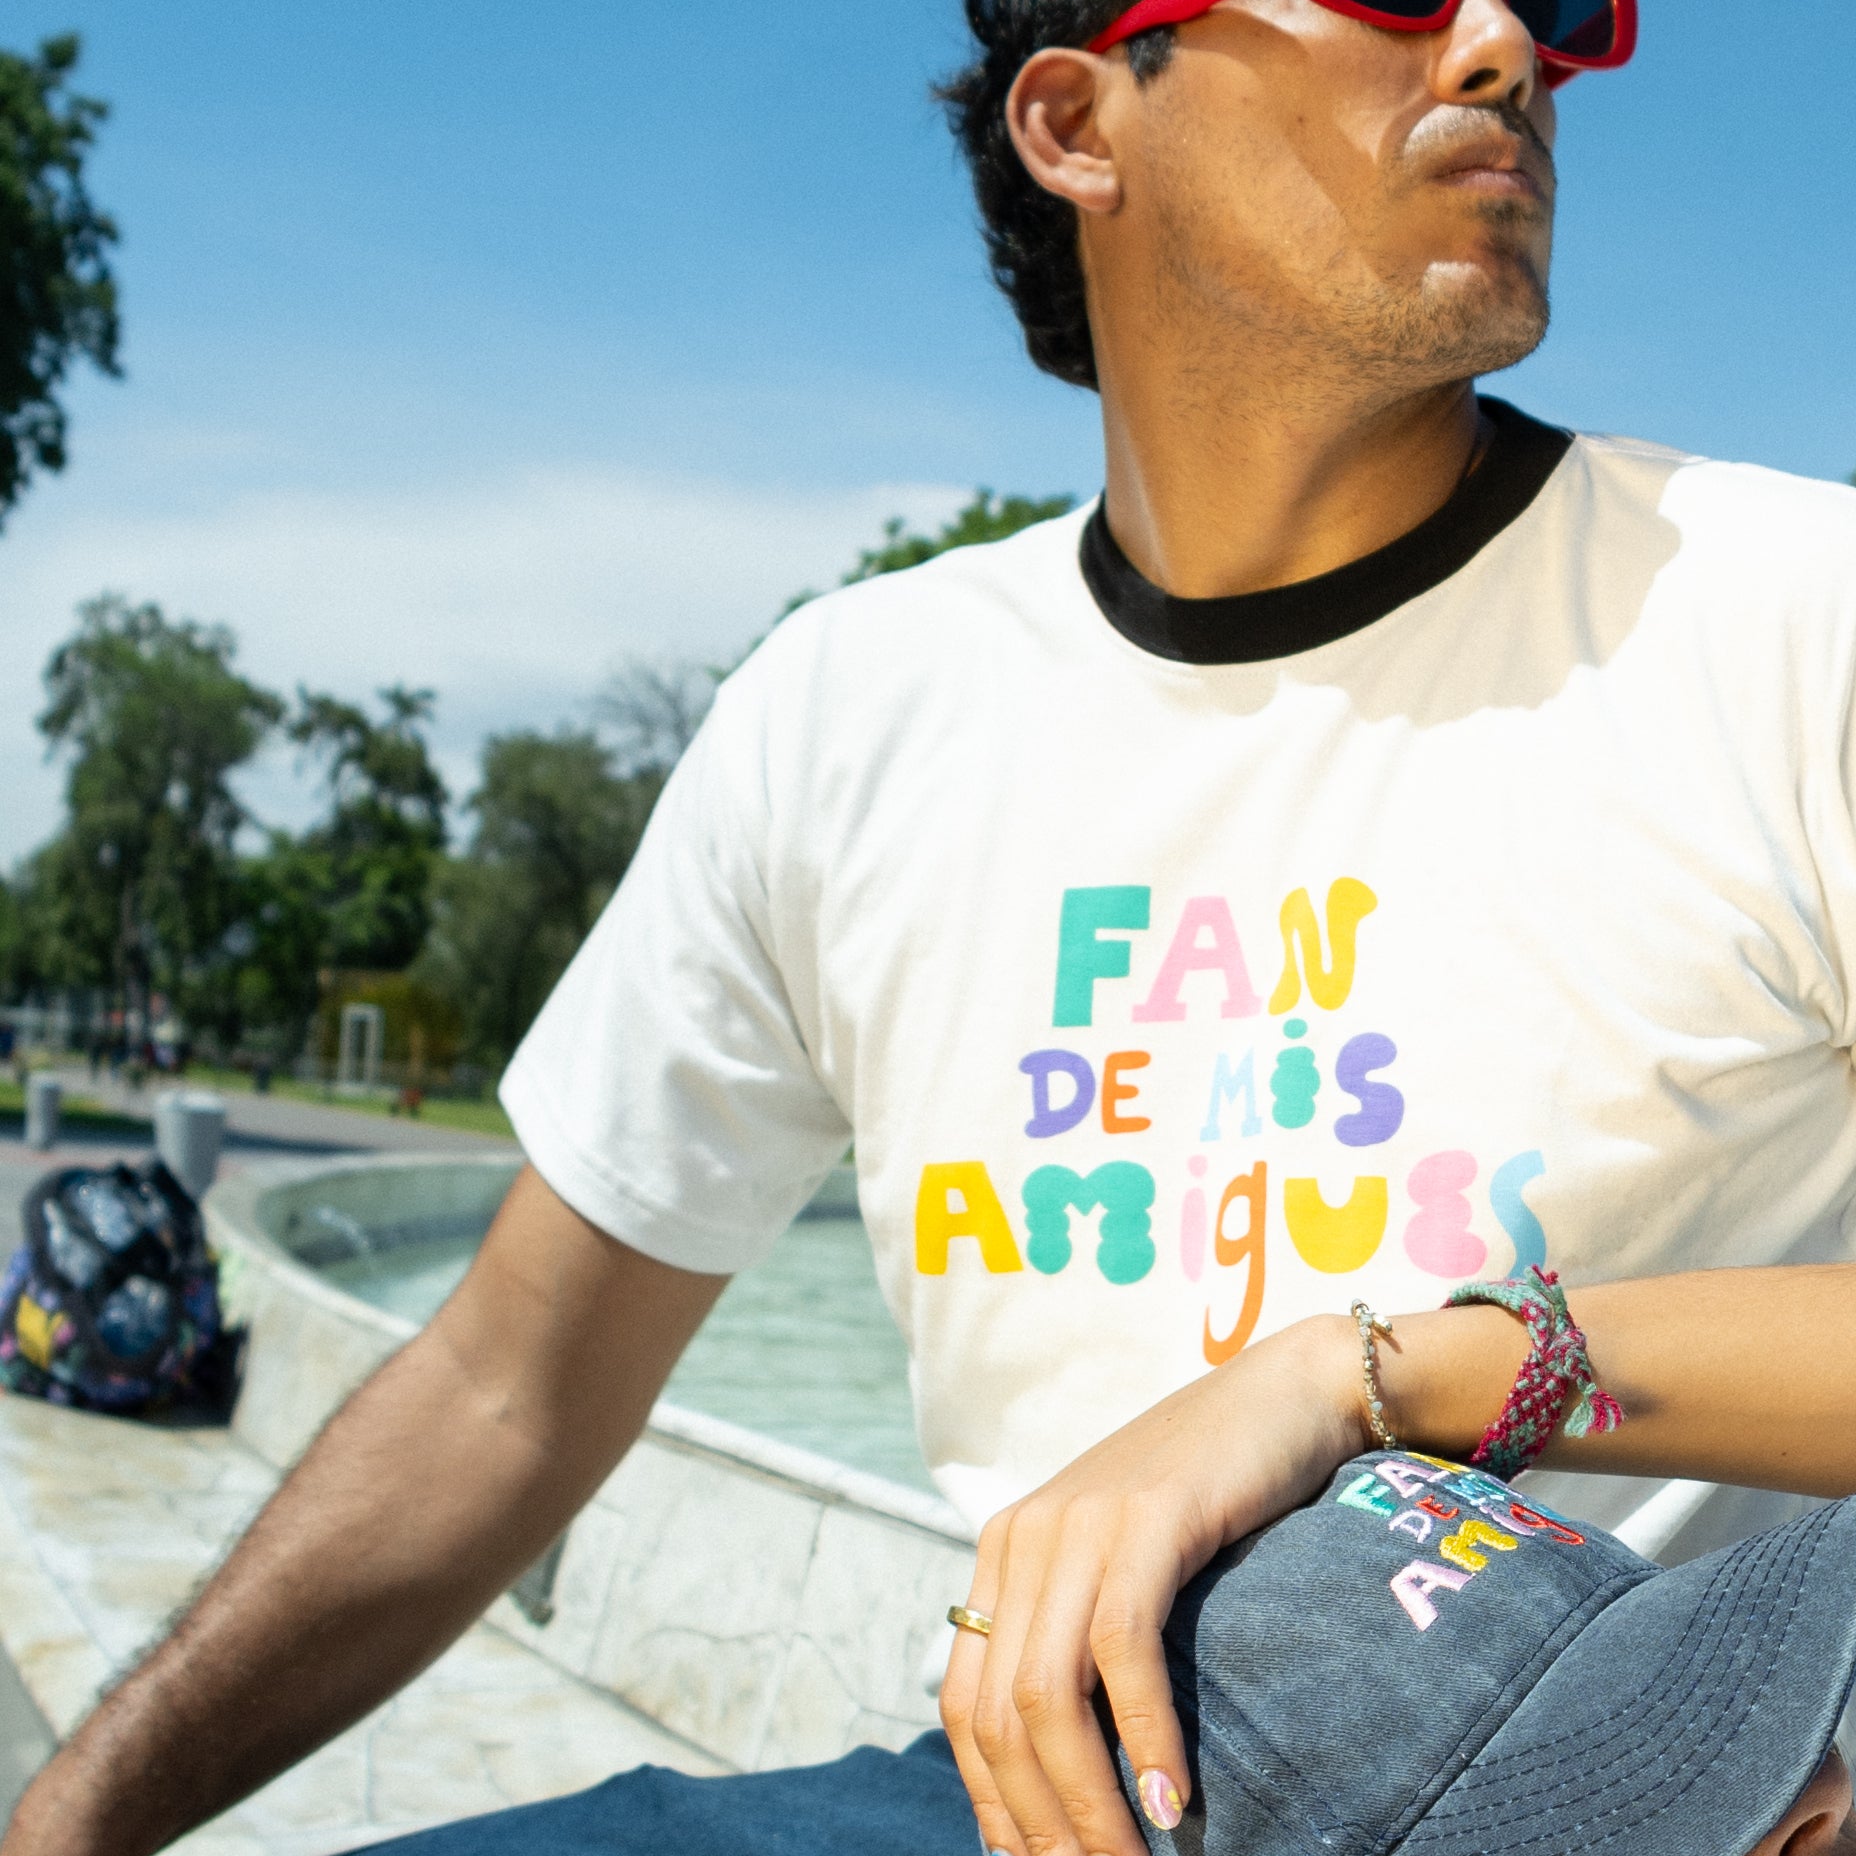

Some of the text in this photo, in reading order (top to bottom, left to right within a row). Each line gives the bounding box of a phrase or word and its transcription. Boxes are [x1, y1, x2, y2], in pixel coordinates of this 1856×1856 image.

[1052, 876, 1378, 1027] FAN
[1018, 1048, 1152, 1138] DE
[1389, 1495, 1459, 1543] DE
